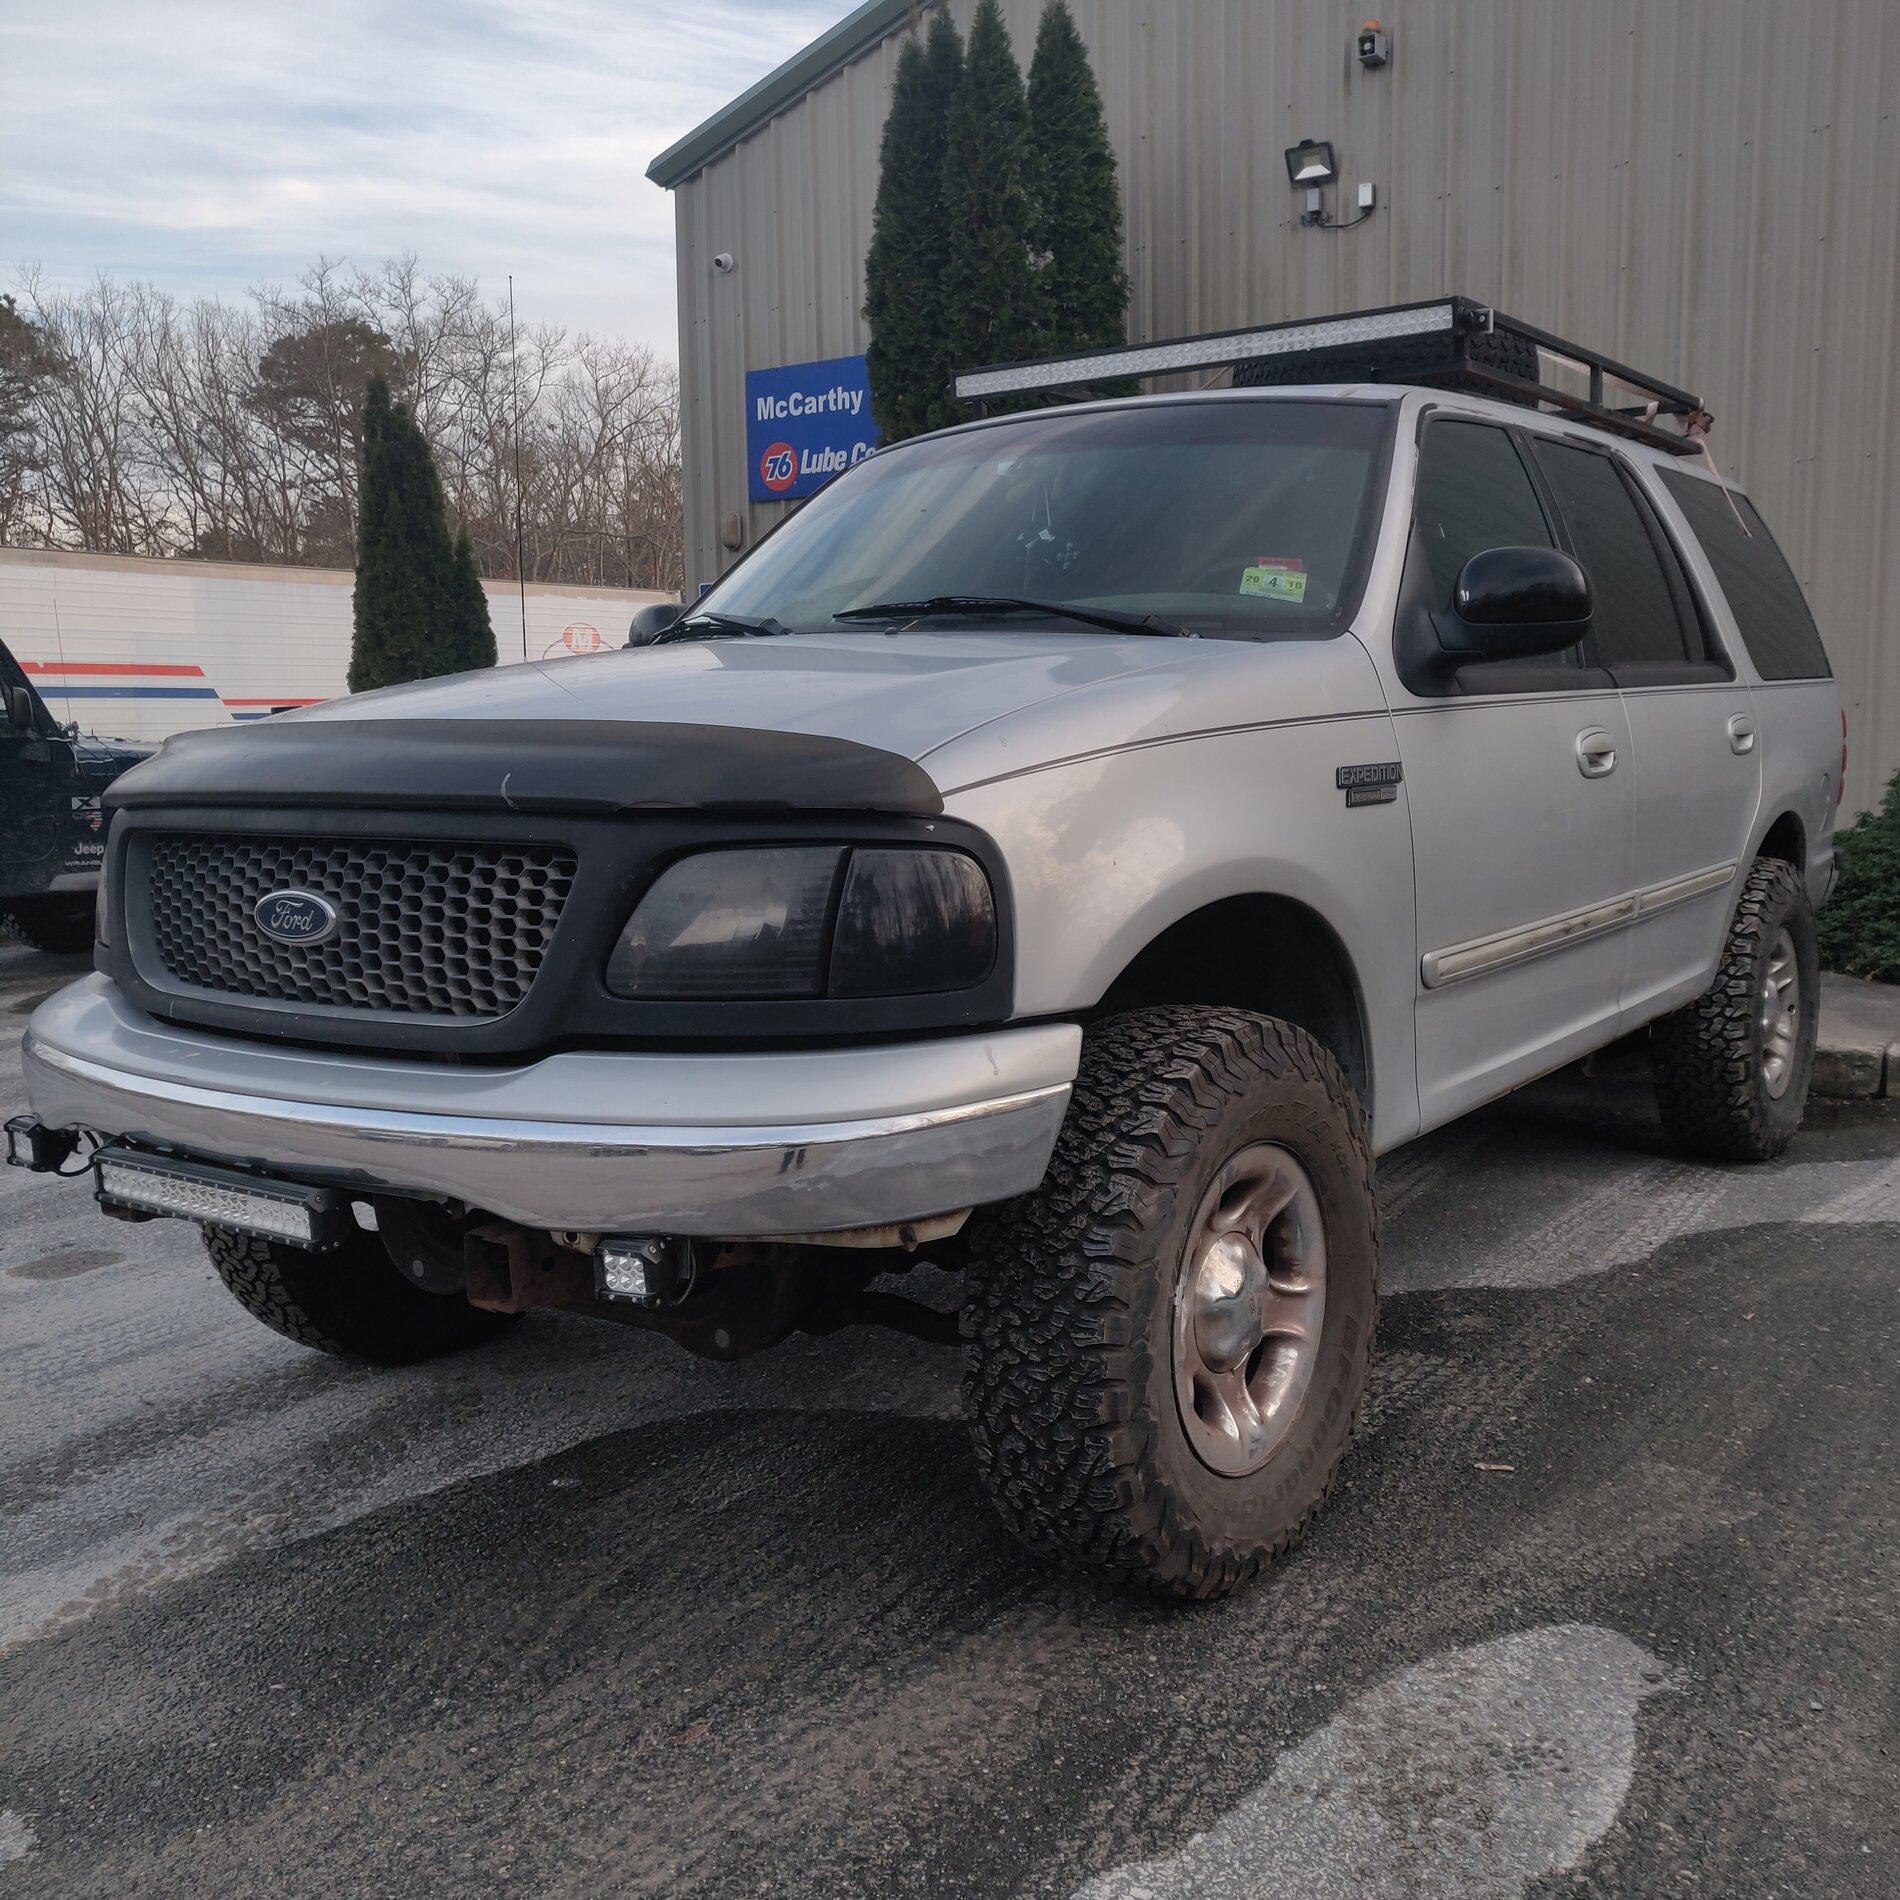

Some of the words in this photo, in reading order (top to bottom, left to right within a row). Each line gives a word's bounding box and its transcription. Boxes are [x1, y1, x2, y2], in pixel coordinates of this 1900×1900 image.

[757, 386, 864, 421] McCarthy
[765, 452, 793, 482] 76
[800, 447, 847, 475] Lube
[1269, 577, 1279, 588] 4
[1340, 763, 1402, 785] EXPEDITION
[73, 842, 104, 856] Jeep
[271, 899, 315, 931] Ford
